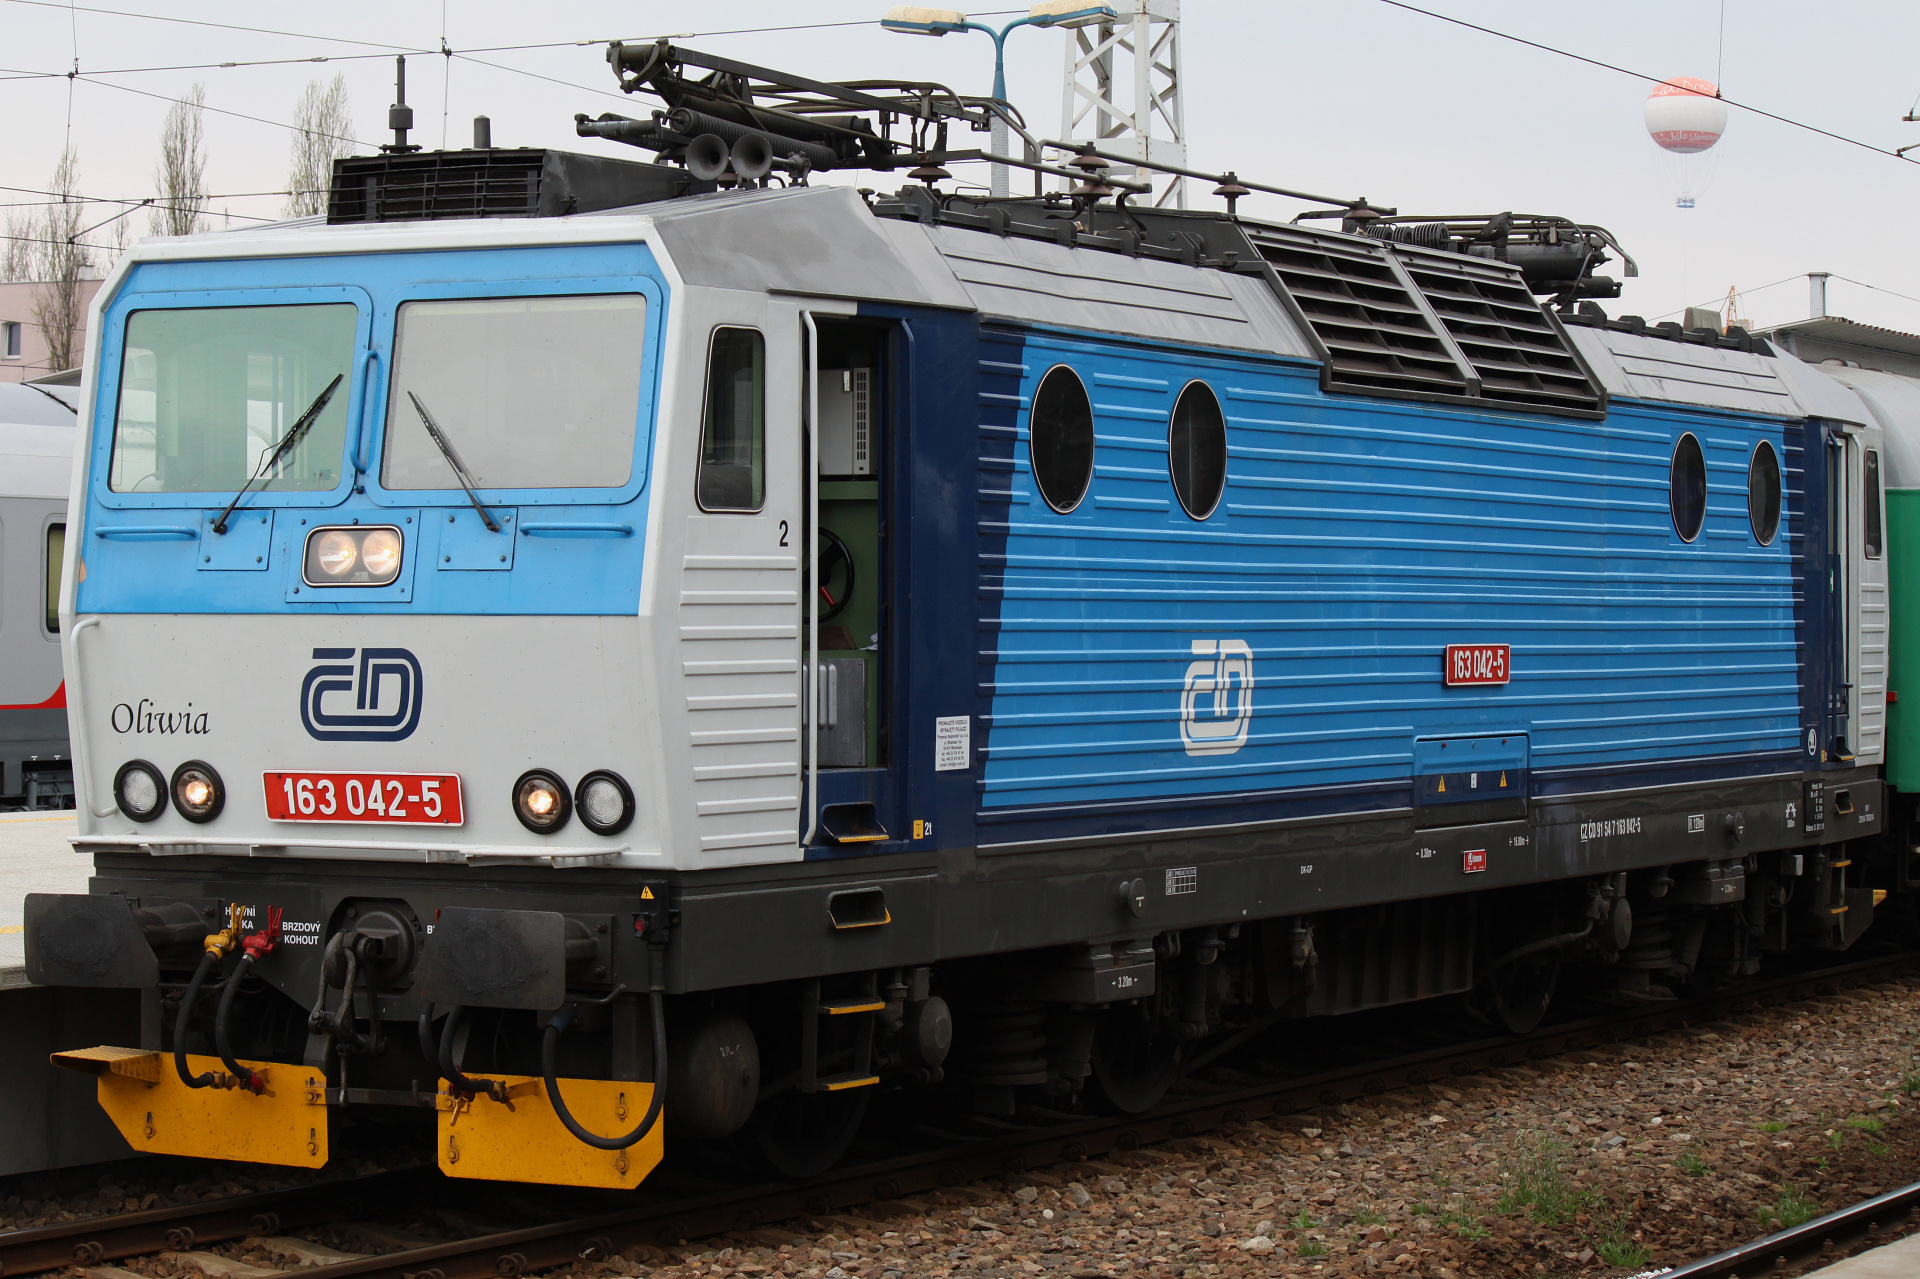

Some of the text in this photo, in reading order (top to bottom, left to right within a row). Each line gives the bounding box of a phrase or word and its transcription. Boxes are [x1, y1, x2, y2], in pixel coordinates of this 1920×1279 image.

[779, 519, 789, 547] 2
[1453, 649, 1505, 679] 163 042-5
[111, 698, 211, 735] Oliwia
[283, 777, 443, 818] 163 042-5
[1580, 823, 1588, 840] CZ
[1596, 821, 1604, 838] 91
[1604, 820, 1612, 837] 54
[1611, 820, 1616, 836] 7
[1616, 819, 1626, 835] 163
[1626, 817, 1641, 833] 042-5
[225, 905, 256, 917] HANÍ
[227, 919, 254, 930] JKA
[282, 920, 321, 933] BRZDOVÝ
[284, 934, 319, 946] KOHOUT
